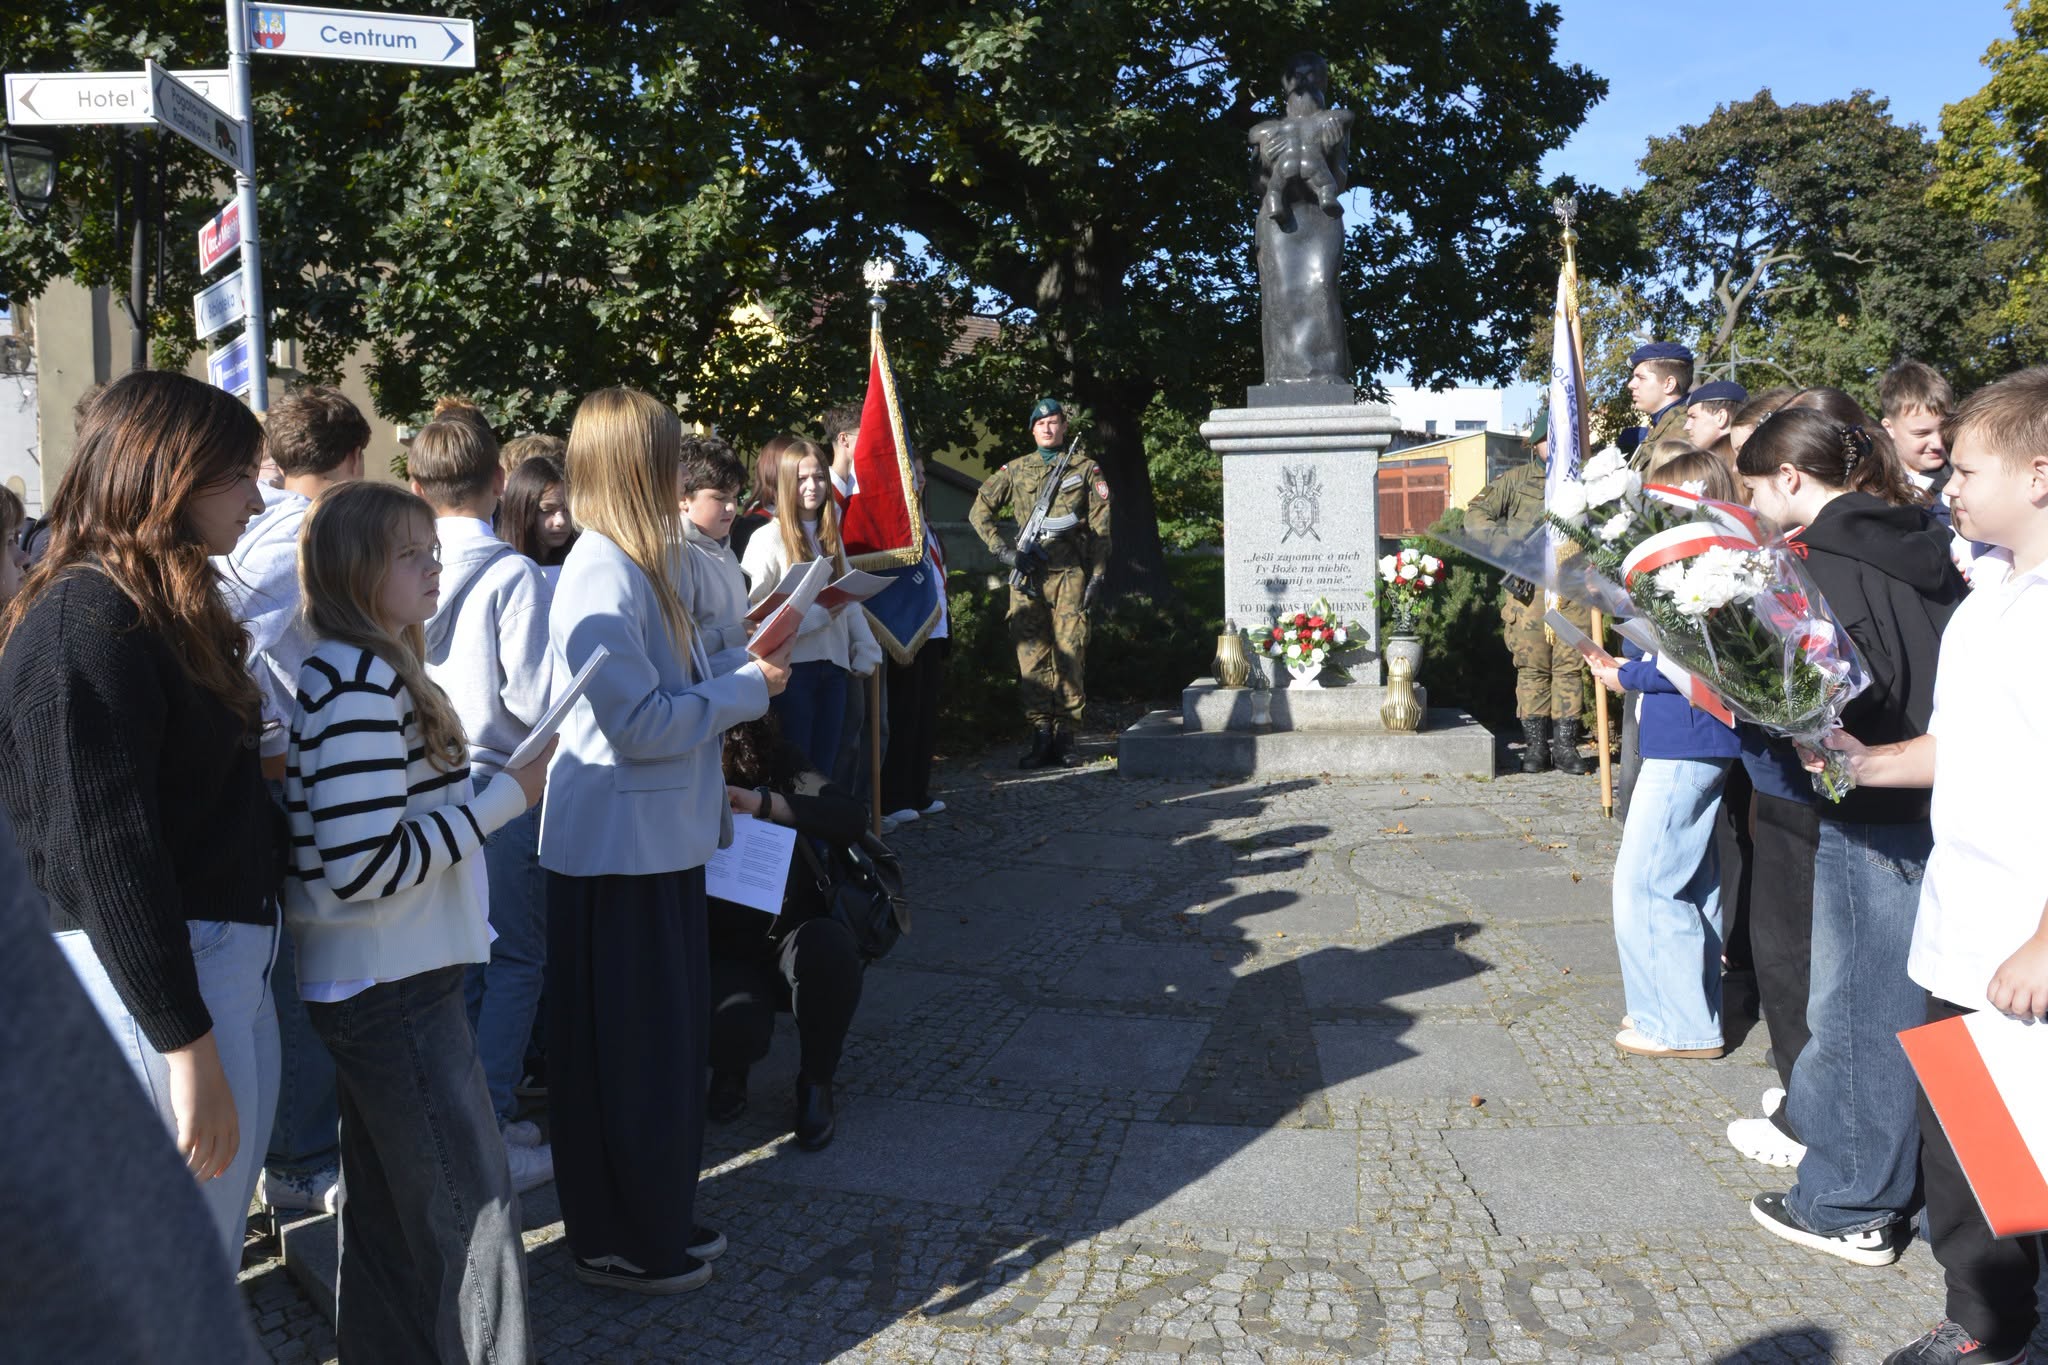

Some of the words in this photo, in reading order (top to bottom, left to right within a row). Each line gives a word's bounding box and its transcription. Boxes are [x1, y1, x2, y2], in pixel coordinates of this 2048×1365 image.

[319, 25, 417, 50] Centrum
[78, 89, 135, 108] Hotel
[1327, 553, 1334, 561] o
[1338, 551, 1360, 561] nich
[1255, 564, 1267, 574] Ty
[1272, 564, 1297, 574] Boże
[1300, 565, 1314, 573] na
[1254, 576, 1304, 587] zapomnij
[1306, 577, 1313, 585] o
[1239, 603, 1252, 613] TO
[1256, 603, 1278, 613] DLA
[1279, 602, 1300, 613] WAS
[1096, 1240, 1666, 1362] 2010
